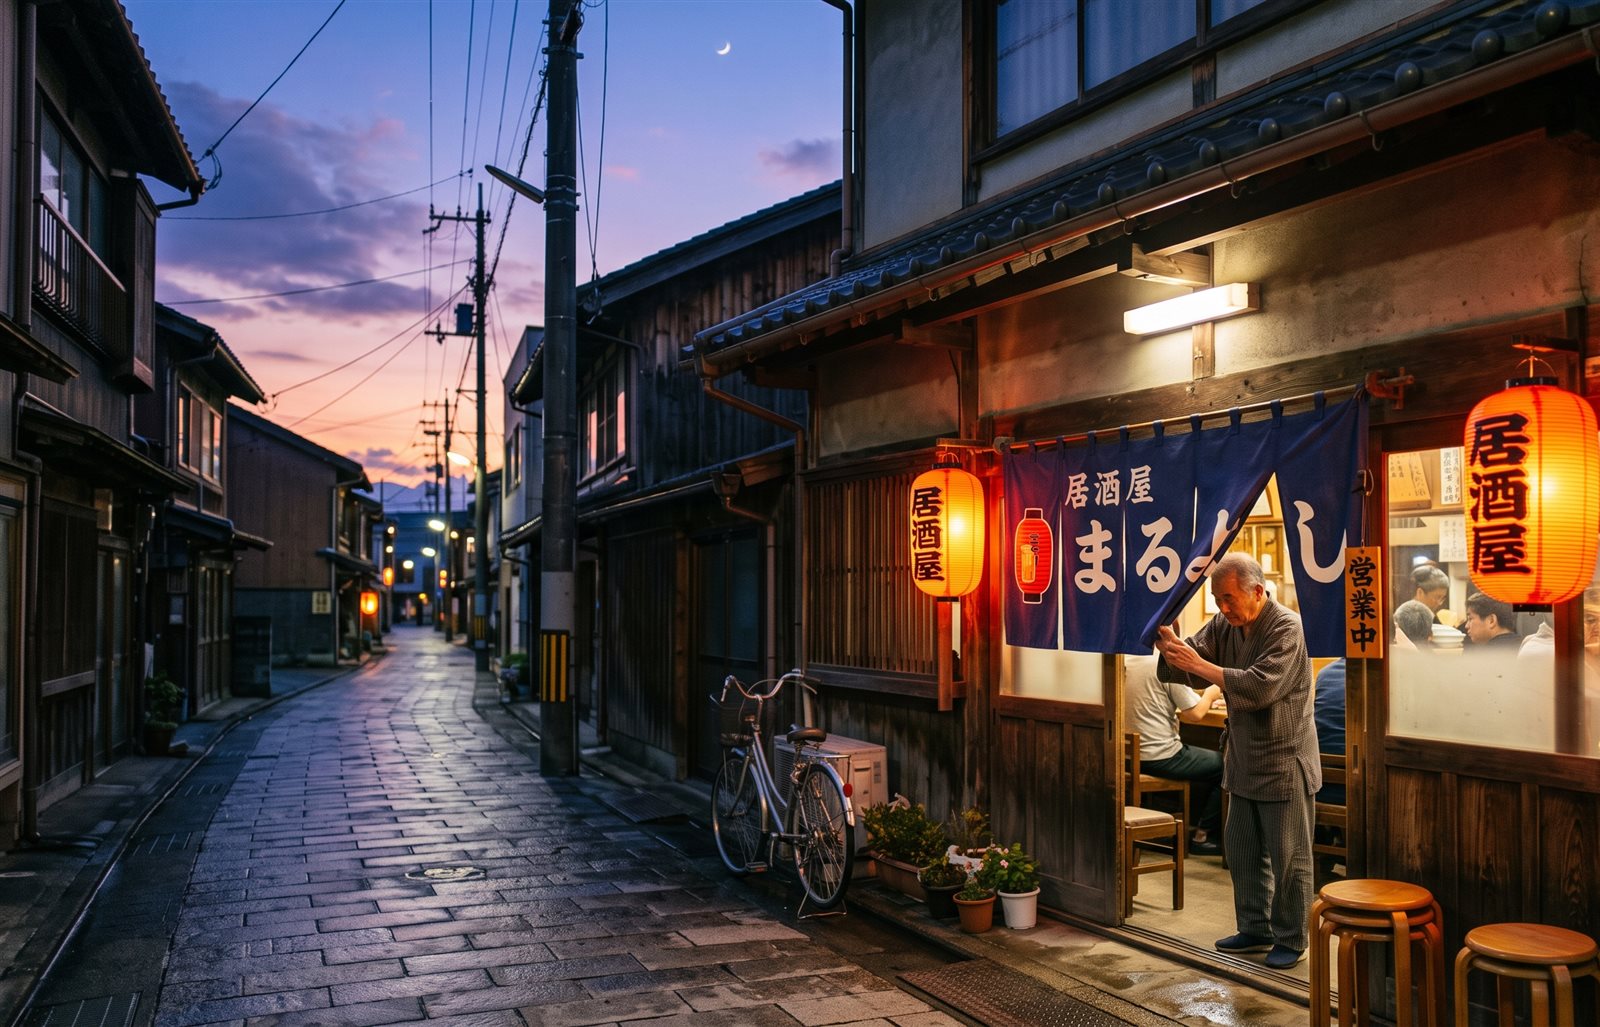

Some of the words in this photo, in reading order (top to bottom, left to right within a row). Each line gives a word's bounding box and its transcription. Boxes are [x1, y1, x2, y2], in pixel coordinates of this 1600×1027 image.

[911, 486, 945, 582] 居酒屋
[1065, 465, 1154, 508] 居酒屋
[1470, 413, 1532, 575] 居酒屋
[1349, 556, 1377, 652] 営業中
